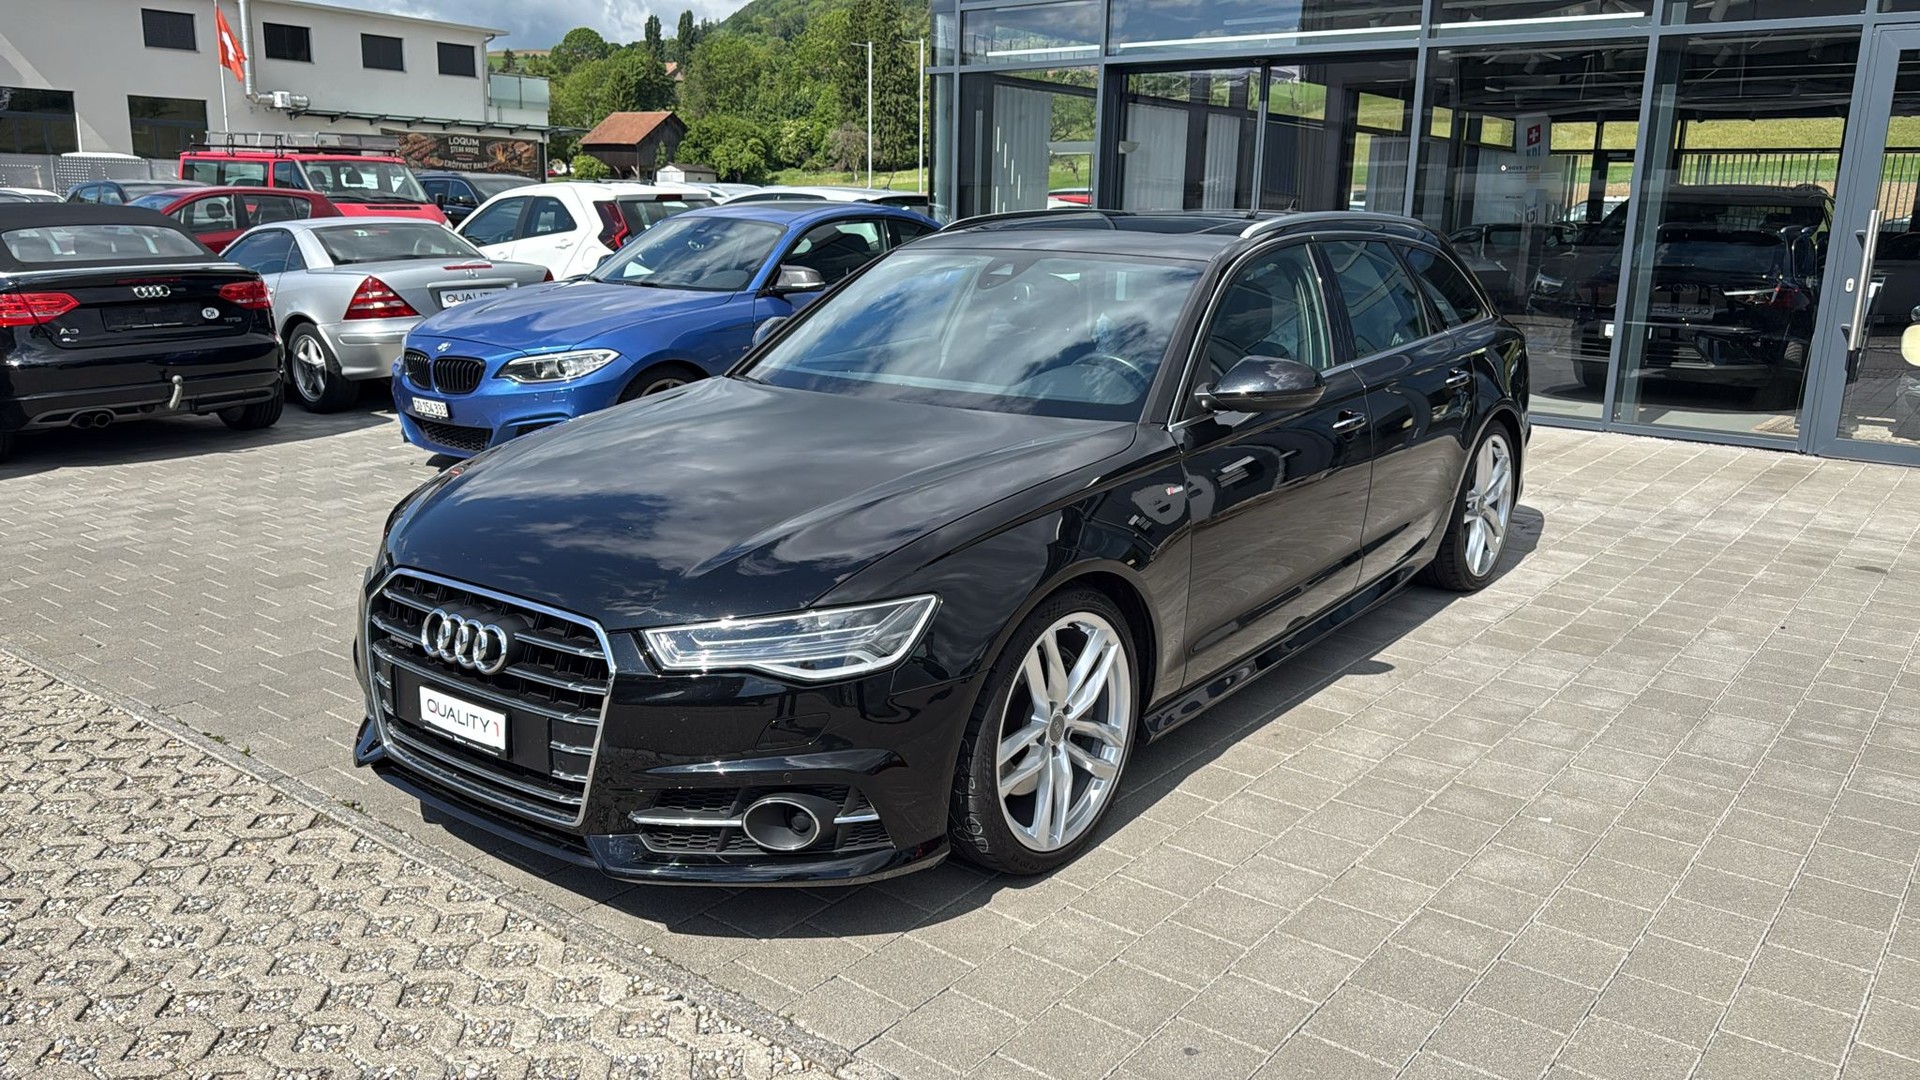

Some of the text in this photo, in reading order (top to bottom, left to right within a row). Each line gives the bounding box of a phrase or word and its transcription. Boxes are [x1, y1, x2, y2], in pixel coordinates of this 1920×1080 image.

[448, 136, 479, 147] LOQUM
[205, 309, 216, 317] CH
[60, 327, 80, 336] A3
[427, 698, 500, 737] QUALITY 1
